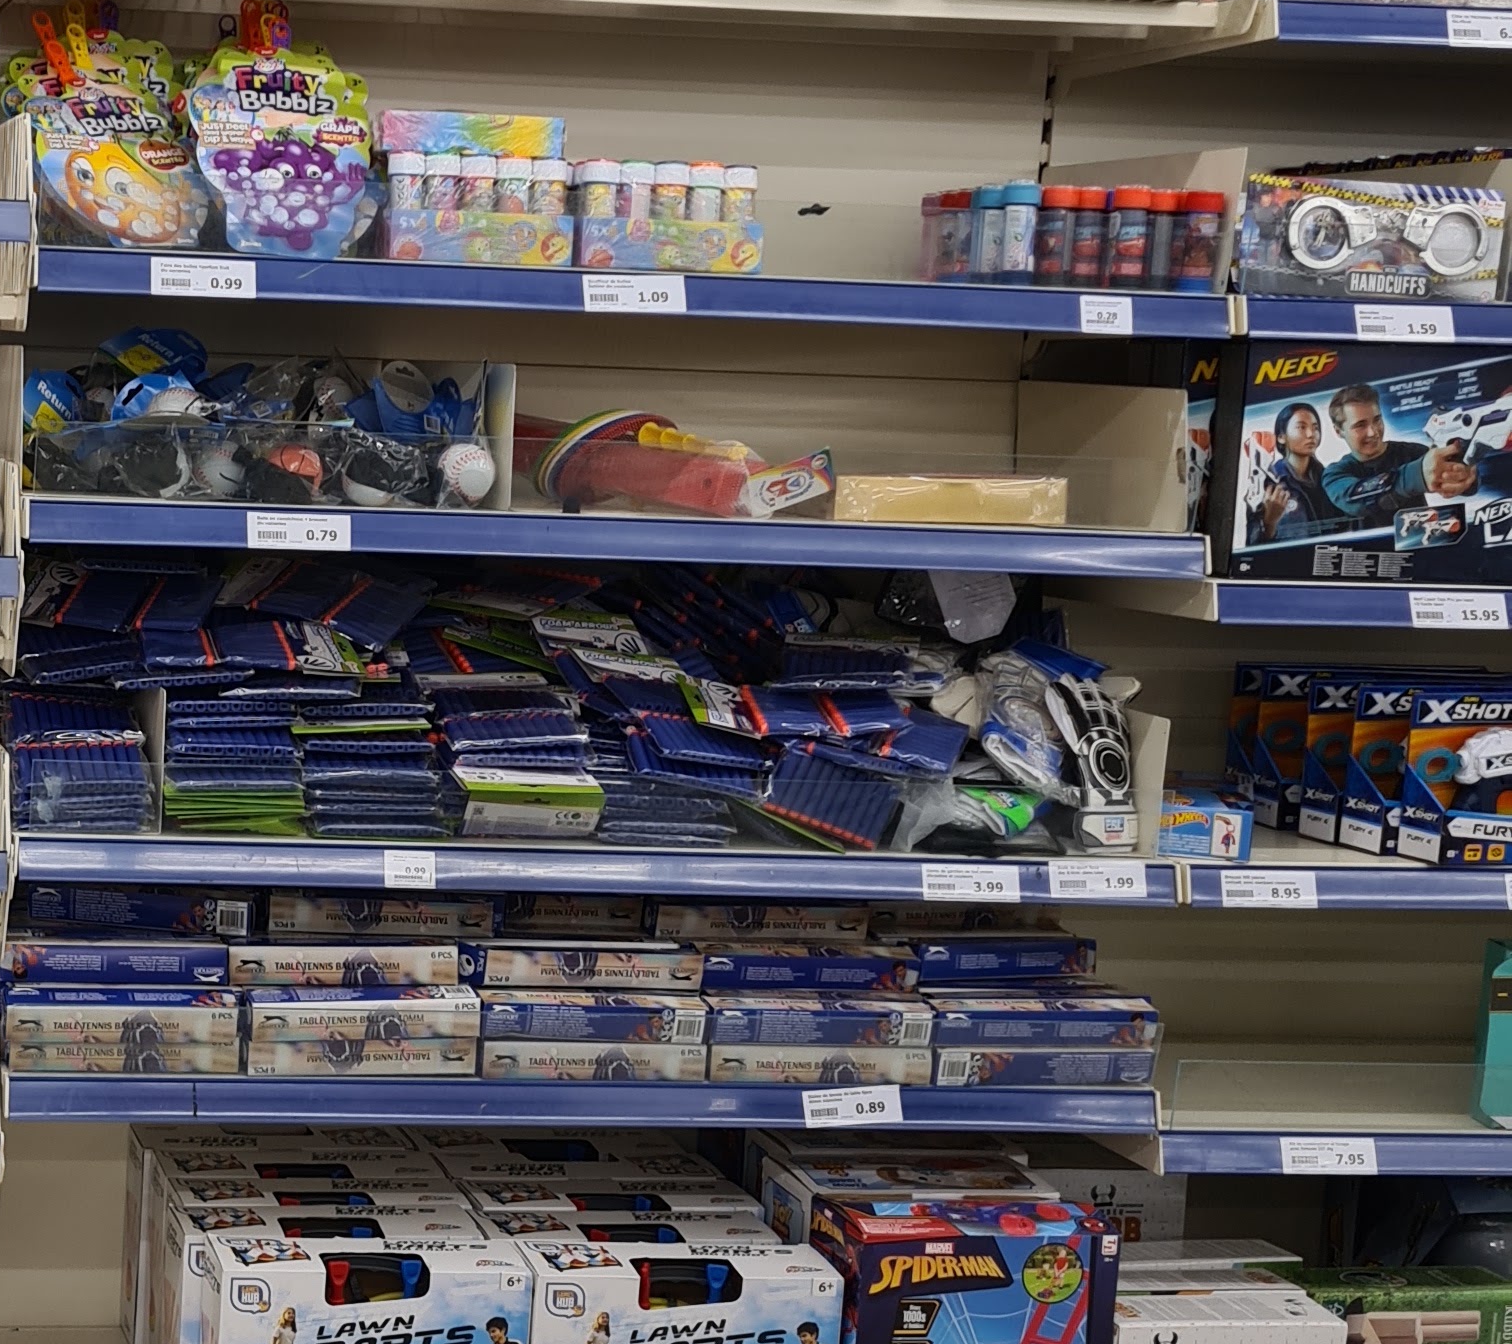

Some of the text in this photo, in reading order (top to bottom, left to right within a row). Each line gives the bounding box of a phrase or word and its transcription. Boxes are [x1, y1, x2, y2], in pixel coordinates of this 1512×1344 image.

[235, 66, 321, 96] Fruity
[66, 96, 141, 119] Fruity
[240, 89, 334, 115] Bubblz
[82, 115, 162, 136] Bubblz
[320, 122, 360, 135] GRAPE
[142, 148, 185, 159] ORANGE
[210, 277, 242, 290] 0.99
[1350, 275, 1427, 296] HANDCUFFS
[638, 291, 668, 303] 1.09
[1407, 323, 1437, 335] 1.59
[137, 332, 175, 359] Return
[1254, 351, 1337, 385] NERF
[37, 379, 72, 420] Return
[305, 529, 337, 542] 0.79
[1461, 609, 1500, 622] 15.95
[405, 866, 426, 875] 0.99
[973, 881, 1004, 893] 3.99
[1105, 877, 1134, 888] 1.99
[1271, 887, 1301, 899] 8.95
[275, 962, 301, 971] TABLE
[303, 962, 334, 971] TENNIS
[53, 1021, 112, 1030] TABLE TENNIS
[299, 1016, 358, 1025] TABLE TENNIS
[56, 1047, 115, 1057] TABLE TENNIS
[529, 1057, 586, 1066] TABLE TENNIS
[756, 1061, 812, 1069] TABLE TENNIS
[855, 1101, 886, 1115] 0.89
[1335, 1153, 1365, 1165] 7.95
[925, 1242, 954, 1255] MARVEL
[868, 1255, 1006, 1294] SPIDER-MAN
[506, 1275, 523, 1287] 6+
[818, 1281, 834, 1292] 6+
[242, 1292, 259, 1304] HUB
[555, 1296, 574, 1308] HUB
[903, 1310, 927, 1324] 1000s
[317, 1314, 415, 1340] LAWN
[629, 1318, 727, 1344] LAWN
